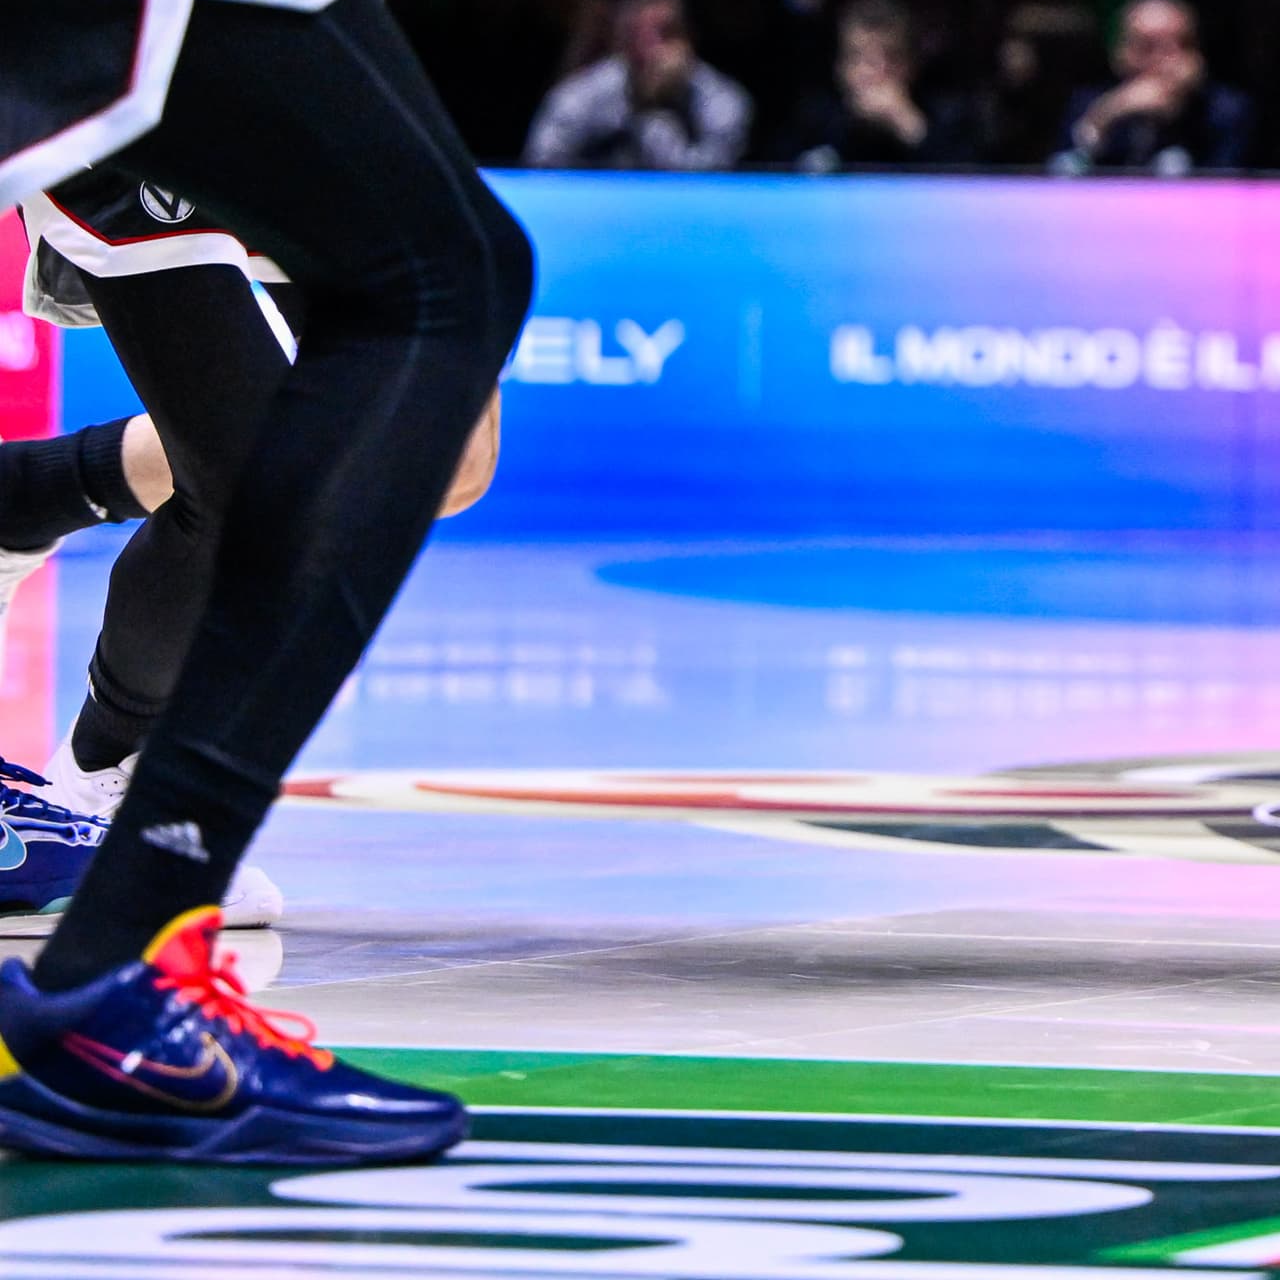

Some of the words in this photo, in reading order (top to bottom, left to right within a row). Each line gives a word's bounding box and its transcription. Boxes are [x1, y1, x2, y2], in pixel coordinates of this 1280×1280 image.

[500, 316, 686, 385] ELY
[830, 324, 894, 385] IL
[895, 324, 1140, 389] MONDO
[1196, 329, 1260, 392] IL
